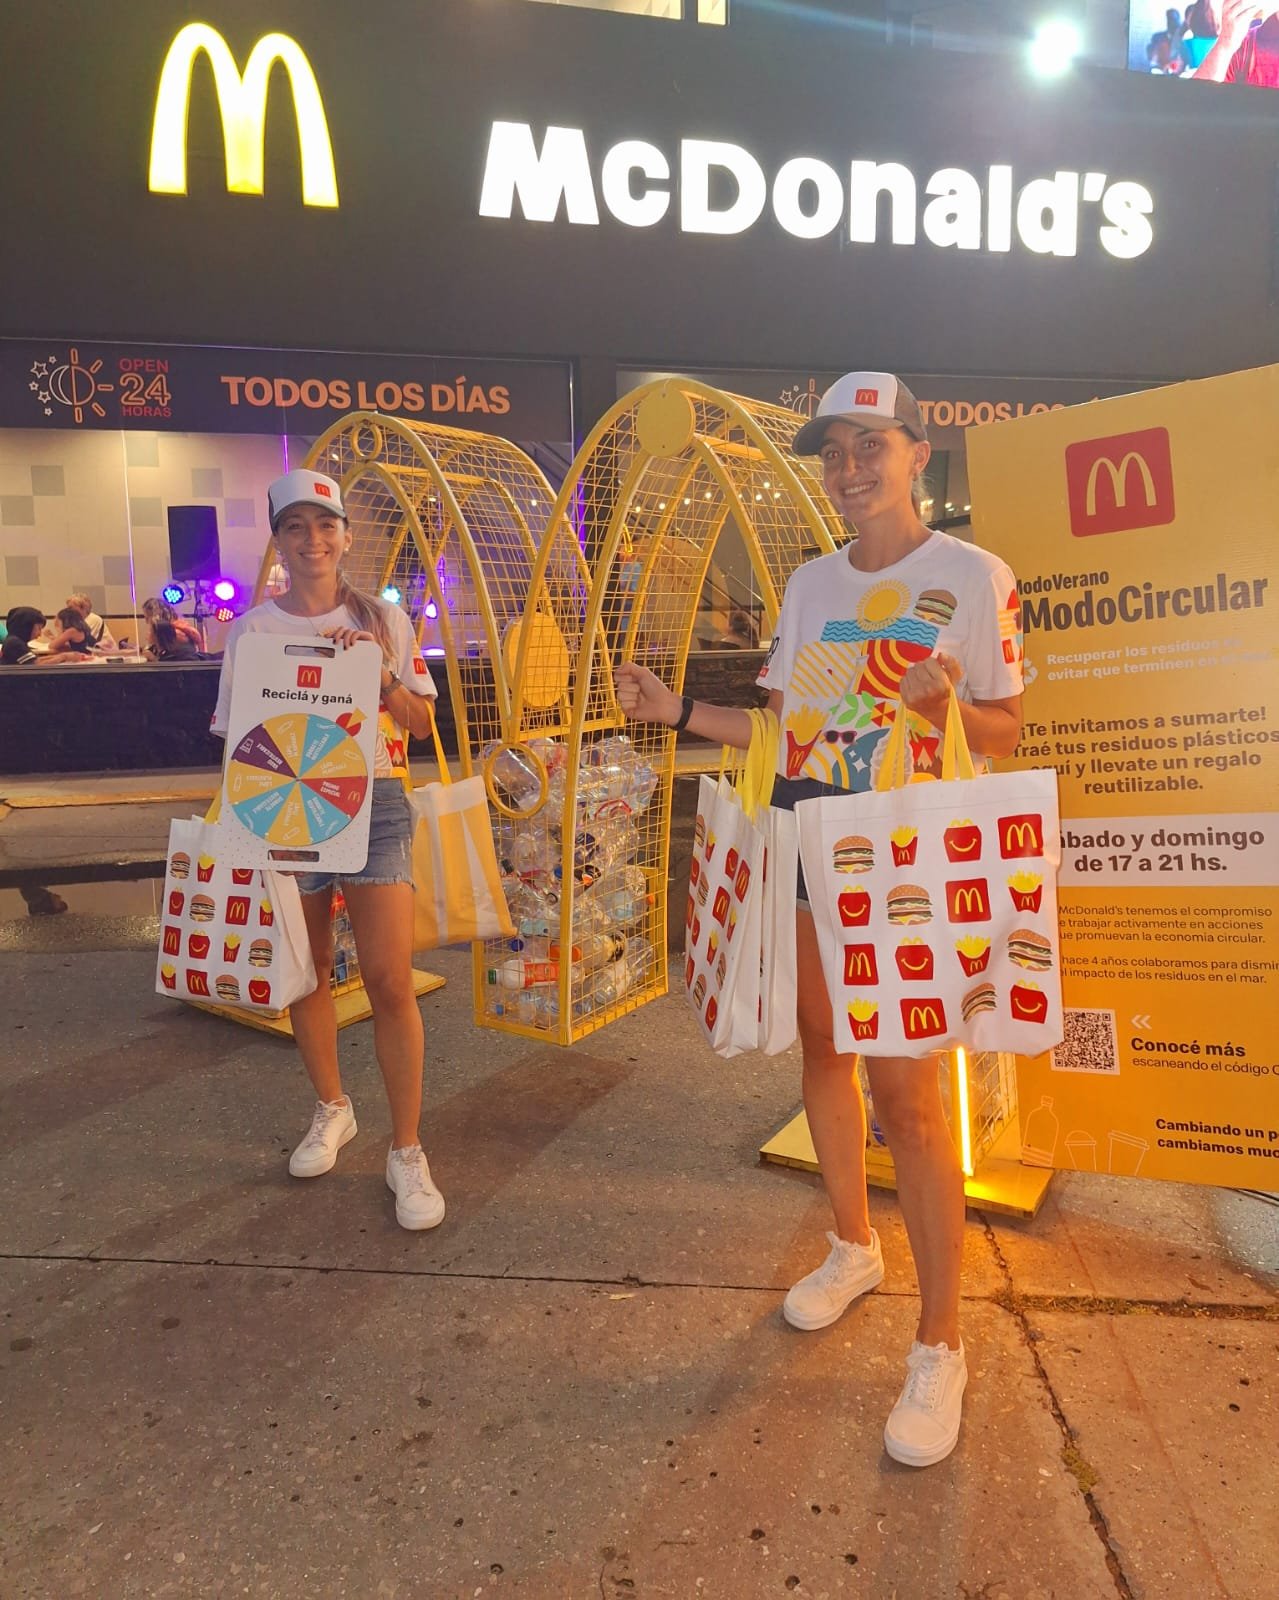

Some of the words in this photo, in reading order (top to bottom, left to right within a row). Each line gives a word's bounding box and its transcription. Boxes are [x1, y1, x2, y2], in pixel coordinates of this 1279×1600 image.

[479, 120, 1155, 260] McDonald's
[119, 358, 169, 373] OPEN
[119, 372, 172, 407] 24
[221, 375, 351, 409] TODOS
[358, 380, 424, 412] LOS
[431, 375, 510, 414] DÍAS
[121, 406, 172, 418] HORAS
[1022, 573, 1269, 634] ModoCircular
[1047, 647, 1123, 666] Recuperar
[1125, 644, 1147, 658] los
[1047, 666, 1089, 681] evitar
[1092, 665, 1121, 680] que
[1124, 658, 1194, 674] terminen
[262, 688, 308, 701] Reciclá
[312, 694, 319, 704] y
[321, 693, 353, 706] ganá
[1021, 722, 1047, 741] ¡Te
[1051, 714, 1149, 736] invitamos
[1154, 716, 1166, 728] a
[1170, 706, 1267, 728] sumarte!
[1055, 739, 1086, 756] tus
[1091, 734, 1178, 753] residuos
[1182, 728, 1279, 751] plásticos
[1075, 763, 1086, 778] y
[1090, 756, 1158, 774] llevate
[1163, 756, 1189, 770] un
[1194, 750, 1262, 772] regalo
[1084, 775, 1204, 795] reutilizable.
[1130, 832, 1145, 852] y
[1150, 826, 1265, 850] domingo
[1074, 855, 1103, 872] de
[1108, 854, 1133, 872] 17
[1138, 858, 1152, 872] a
[1158, 853, 1183, 872] 21
[1191, 852, 1228, 871] hs.
[1058, 905, 1123, 916] McDonald's
[1126, 906, 1178, 917] tenemos
[1180, 906, 1191, 917] el
[1193, 906, 1273, 919] compromiso
[1068, 917, 1111, 930] trabajar
[1113, 918, 1187, 930] activamente
[1189, 920, 1205, 930] en
[1207, 919, 1264, 931] acciones
[1076, 932, 1140, 943] promuevan
[1142, 931, 1152, 941] la
[1217, 933, 1266, 944] circular.
[1091, 956, 1098, 965] 4
[1100, 956, 1129, 967] años
[1130, 957, 1208, 970] colaboramos
[1210, 960, 1238, 971] para
[1069, 969, 1116, 981] impacto
[1118, 969, 1133, 979] de
[1135, 969, 1152, 980] los
[1154, 970, 1206, 983] residuos
[1208, 973, 1223, 983] en
[1226, 972, 1237, 983] el
[1240, 974, 1268, 984] mar.
[1130, 1037, 1201, 1055] Conocé
[1205, 1041, 1246, 1057] más
[1132, 1057, 1209, 1071] escaneando
[1210, 1059, 1222, 1072] el
[1224, 1061, 1271, 1077] código
[1156, 1118, 1242, 1137] Cambiando
[1245, 1128, 1265, 1139] un
[1268, 1130, 1279, 1142] p
[1157, 1137, 1244, 1155] cambiamos
[1247, 1146, 1279, 1159] muc
